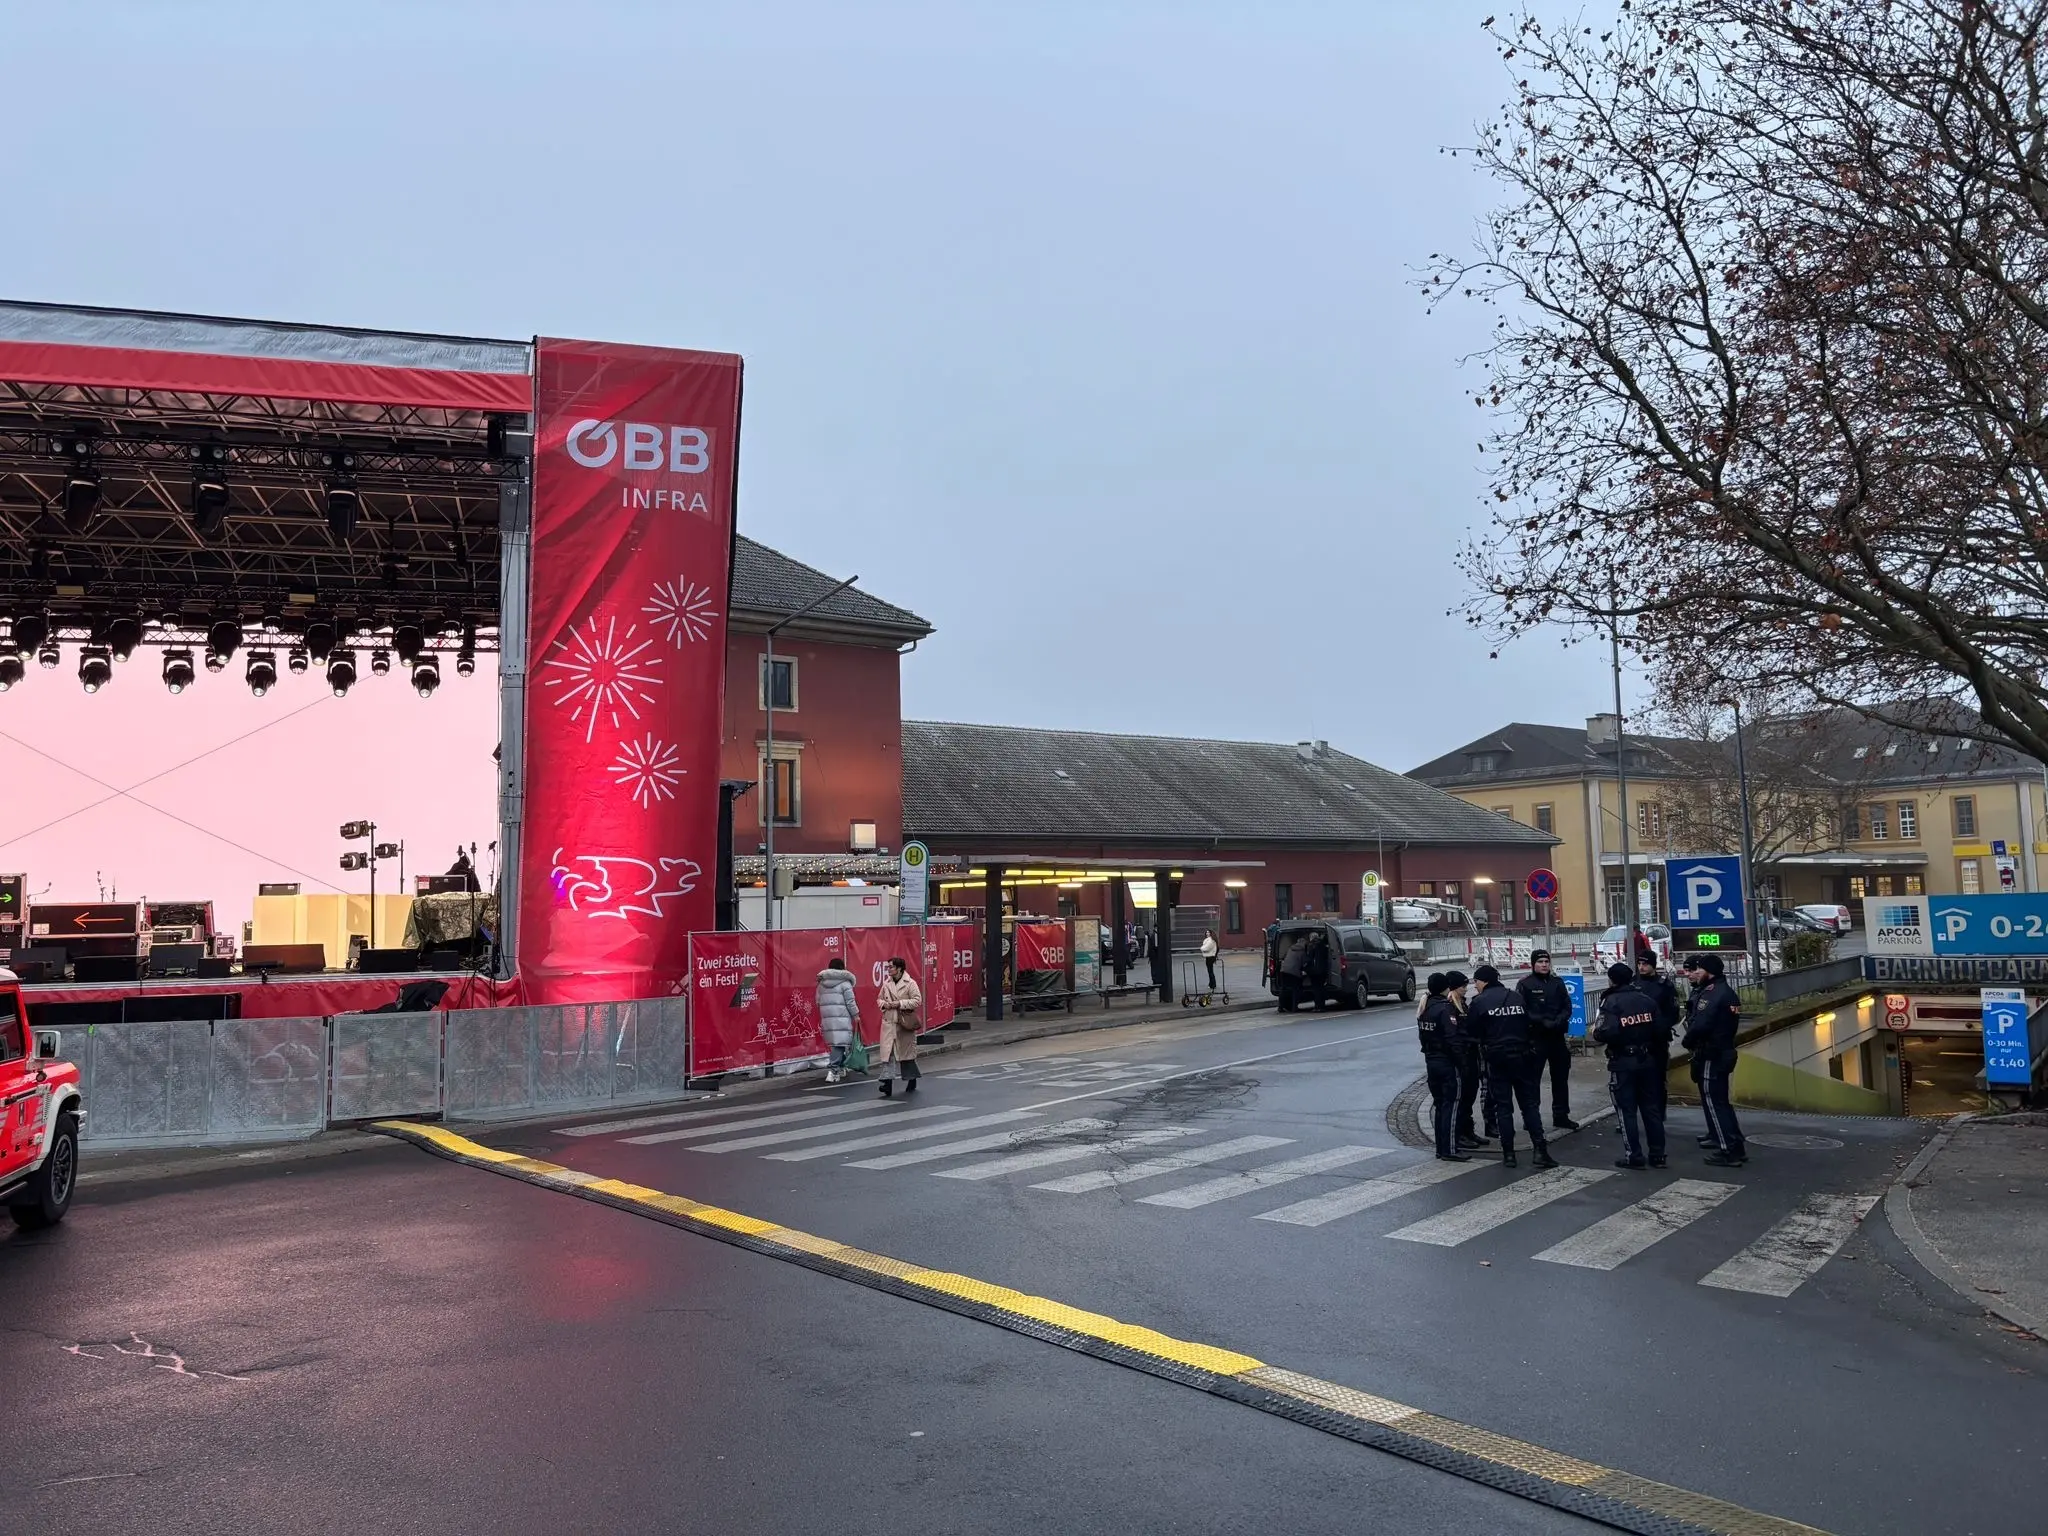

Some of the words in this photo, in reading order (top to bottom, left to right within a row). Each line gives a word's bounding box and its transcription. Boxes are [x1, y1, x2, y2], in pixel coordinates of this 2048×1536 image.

[622, 487, 708, 513] INFRA
[1877, 927, 1921, 937] APCOA
[1990, 914, 2048, 938] 0-2
[1697, 934, 1720, 946] FREI
[1877, 936, 1923, 945] PARKING
[697, 955, 722, 970] Zwei
[724, 953, 759, 968] Städte,
[954, 949, 973, 968] BB
[699, 974, 712, 988] ein
[715, 972, 739, 987] Fest!
[1620, 1012, 1653, 1028] POLIZEI
[1987, 1039, 2006, 1047] 0-30
[2007, 1039, 2025, 1048] Min.
[1989, 1057, 1997, 1067] €
[2000, 1058, 2026, 1069] 1,40
